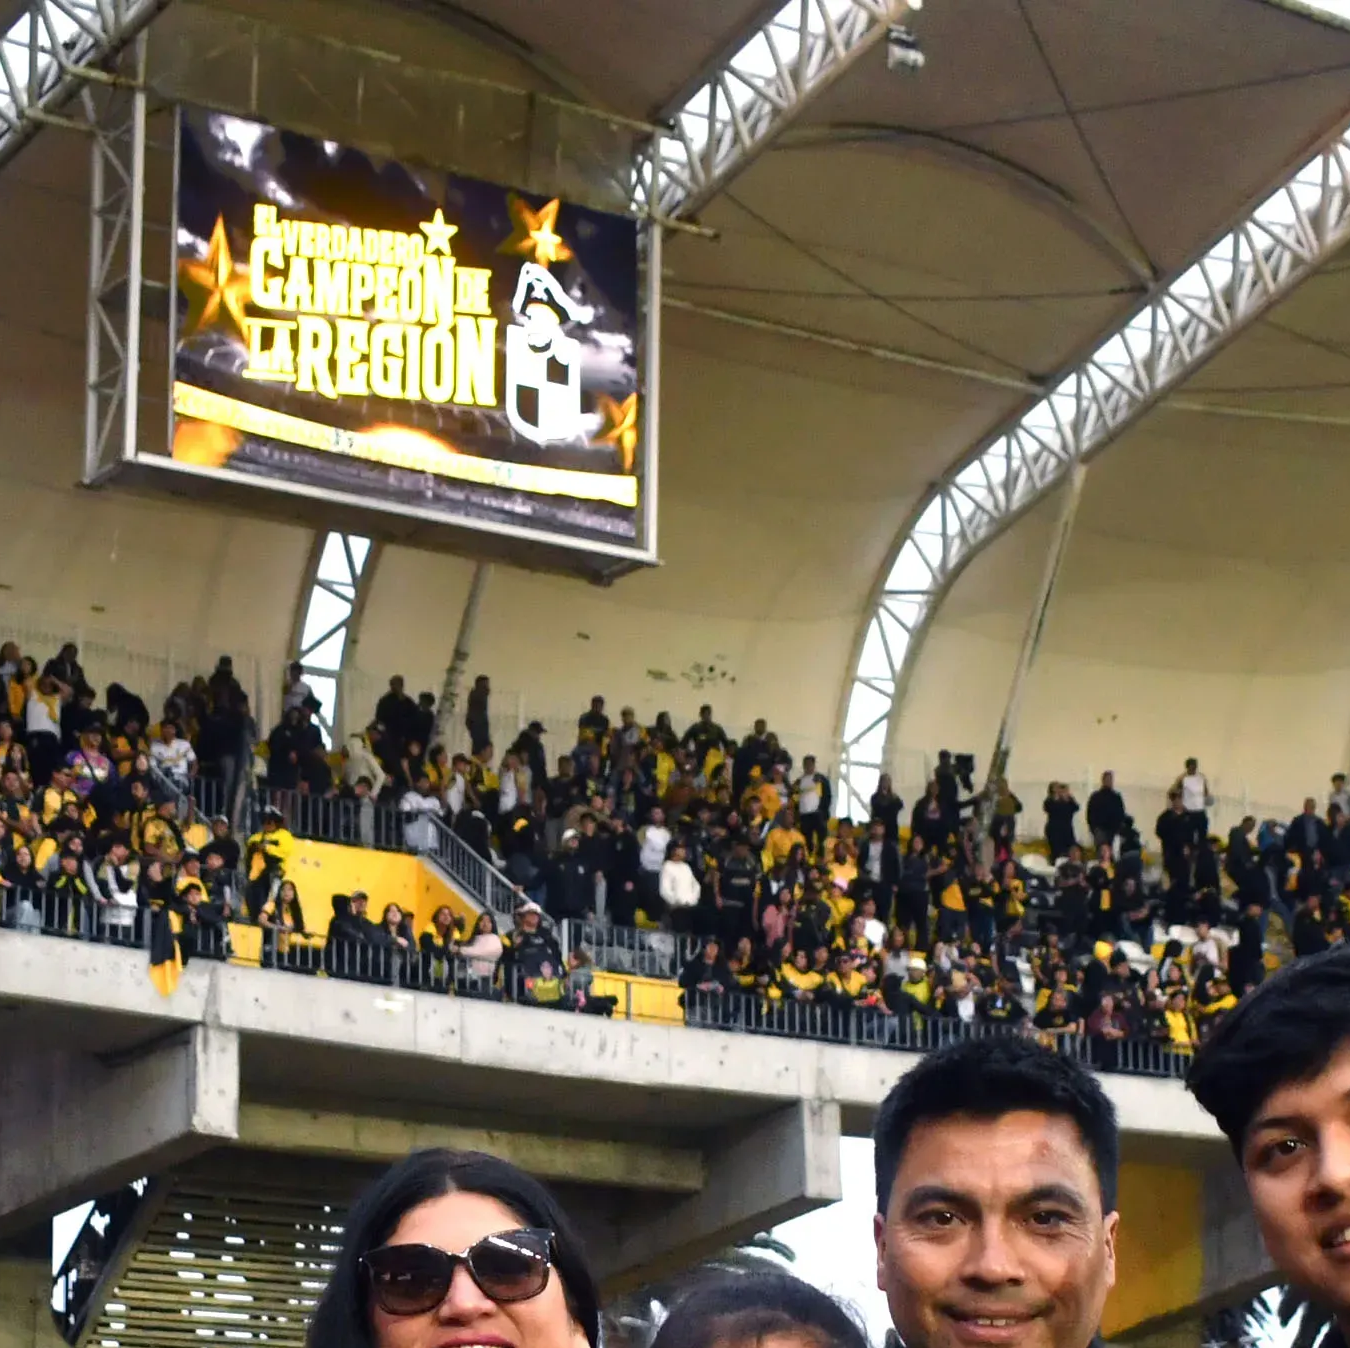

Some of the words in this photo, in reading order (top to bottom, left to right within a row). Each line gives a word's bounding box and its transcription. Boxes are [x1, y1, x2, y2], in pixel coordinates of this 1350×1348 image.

[254, 204, 282, 237] EL
[280, 219, 425, 270] VERDADERO
[454, 266, 492, 315] DE
[243, 317, 298, 382] LA
